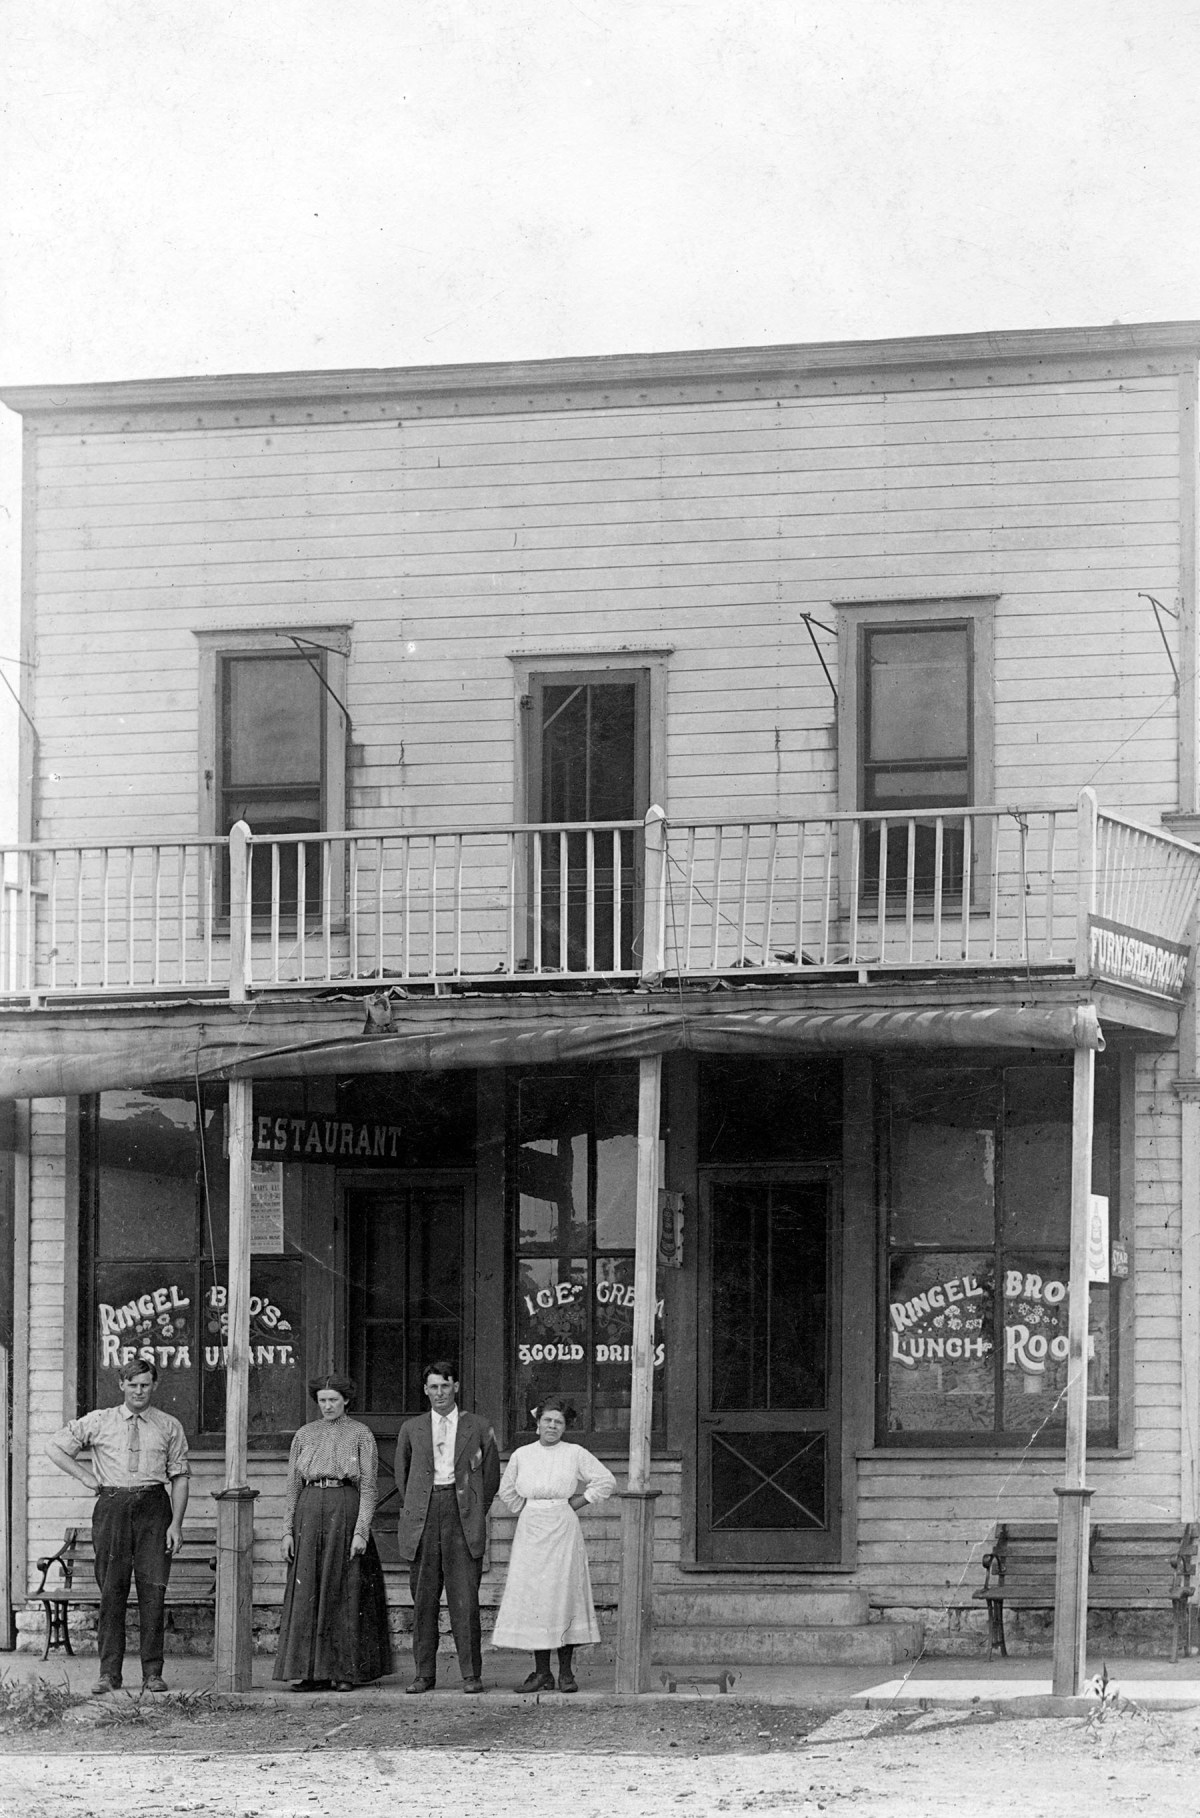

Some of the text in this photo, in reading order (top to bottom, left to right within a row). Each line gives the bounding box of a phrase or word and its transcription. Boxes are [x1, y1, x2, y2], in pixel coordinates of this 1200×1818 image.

[1089, 926, 1188, 991] FURNISHED ROOMS
[251, 1116, 402, 1157] ESTAURANT
[99, 1285, 281, 1335] RINGEL BO'S
[524, 1281, 665, 1318] ICE CRE
[890, 1270, 1092, 1332] RINGEL BRO
[102, 1334, 296, 1368] RESTAUNT.
[596, 1343, 665, 1367] DRIS
[892, 1325, 1095, 1370] LUNCH ROO
